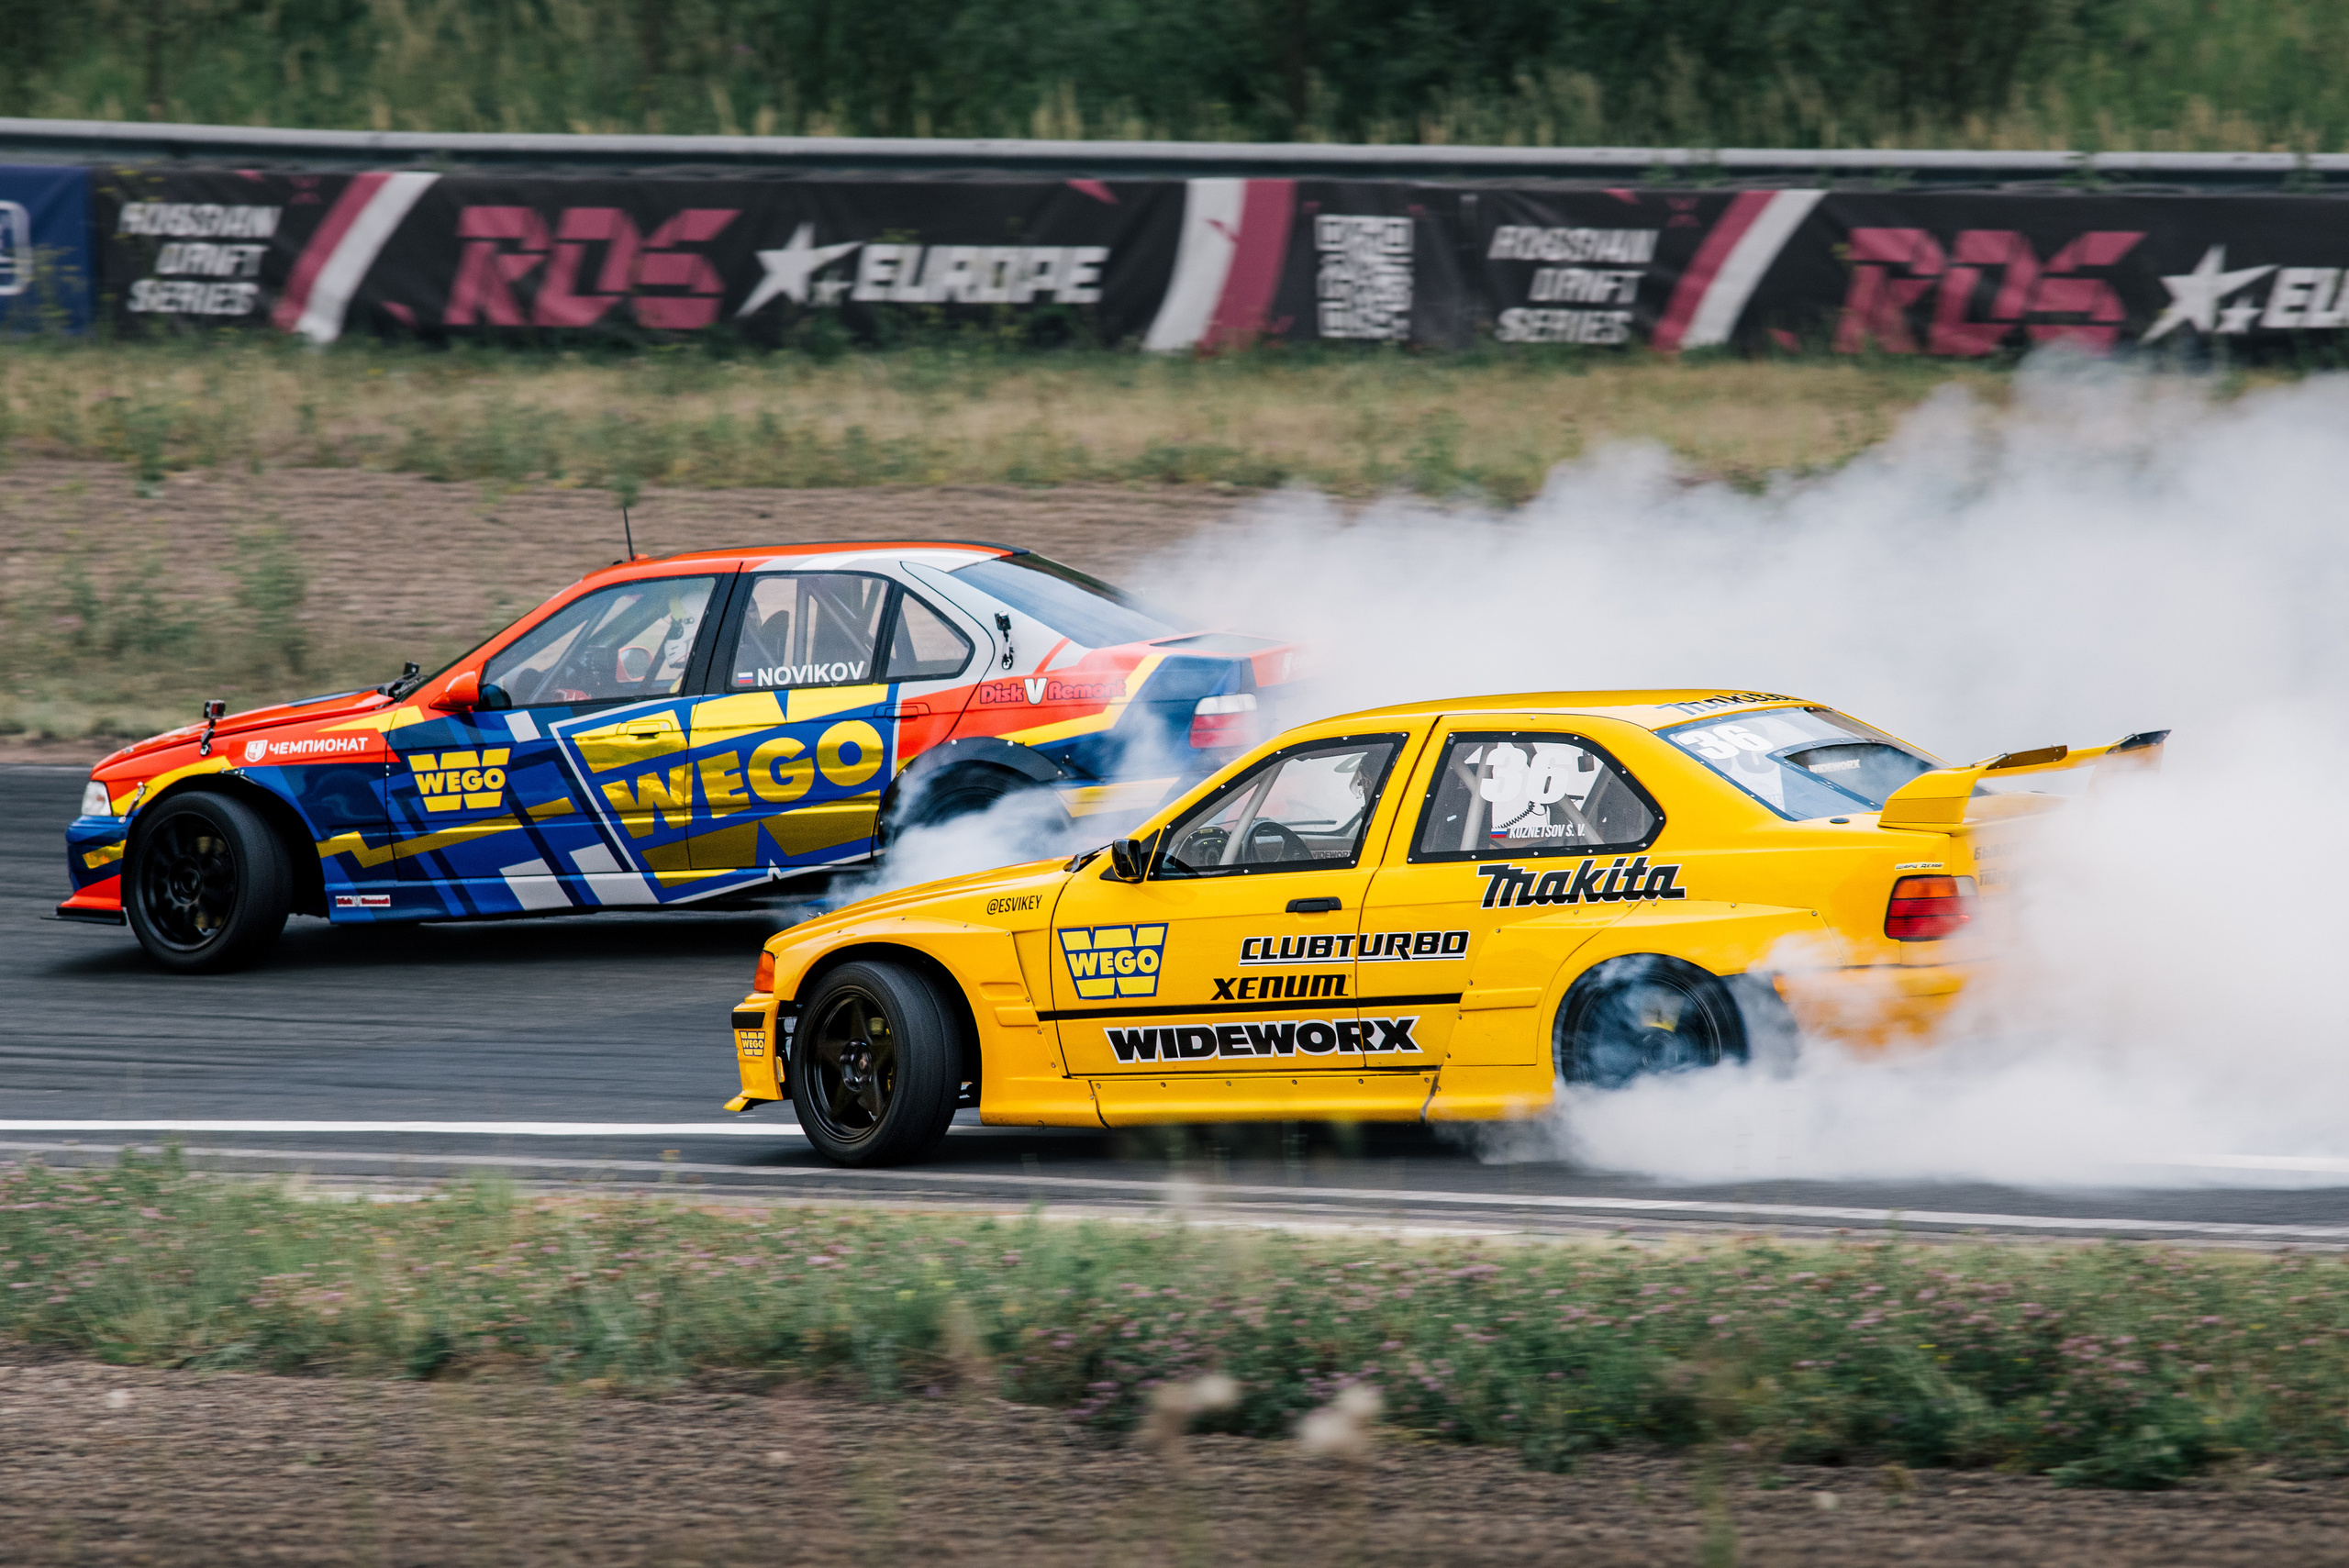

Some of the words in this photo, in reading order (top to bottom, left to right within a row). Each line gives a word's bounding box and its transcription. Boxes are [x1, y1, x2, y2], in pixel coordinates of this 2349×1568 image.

[757, 660, 865, 686] NOVIKOV
[980, 683, 1024, 704] Disk
[269, 737, 369, 755] ЧЕМПИОНАТ
[1676, 724, 1775, 760] 36
[414, 767, 506, 795] WEGO
[600, 720, 884, 839] WEGO
[1479, 747, 1574, 806] 36
[1508, 823, 1565, 839] KUZNETSOV
[986, 895, 1042, 915] @ESVIKEY
[1240, 929, 1470, 963] CLUBTURBO
[1067, 948, 1161, 977] WEGO
[1210, 973, 1349, 1001] XENUM
[741, 1039, 764, 1049] WEGO
[1103, 1016, 1424, 1064] WIDEWORX
